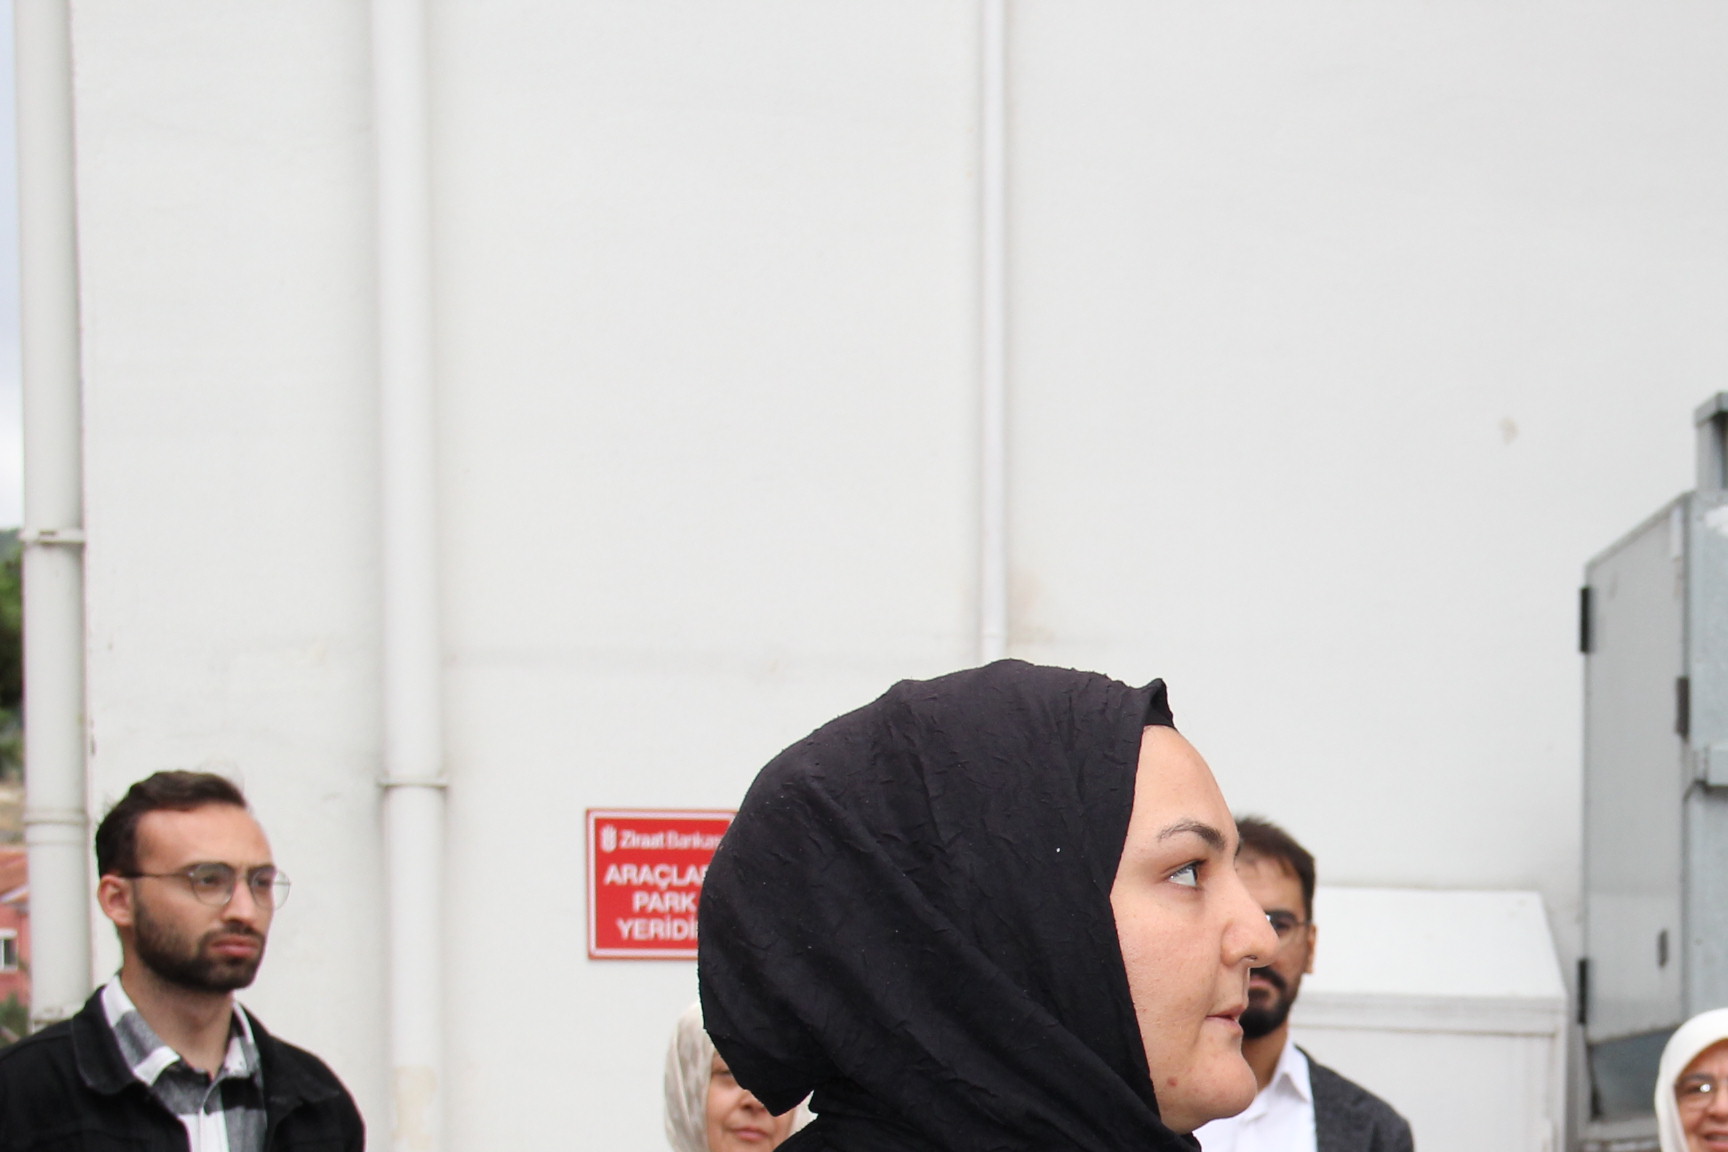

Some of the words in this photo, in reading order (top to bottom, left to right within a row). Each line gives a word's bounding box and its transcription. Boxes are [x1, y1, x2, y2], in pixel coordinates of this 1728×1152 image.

[620, 830, 664, 850] Ziraat
[632, 892, 697, 912] PARK
[616, 914, 698, 940] YERİDİ
